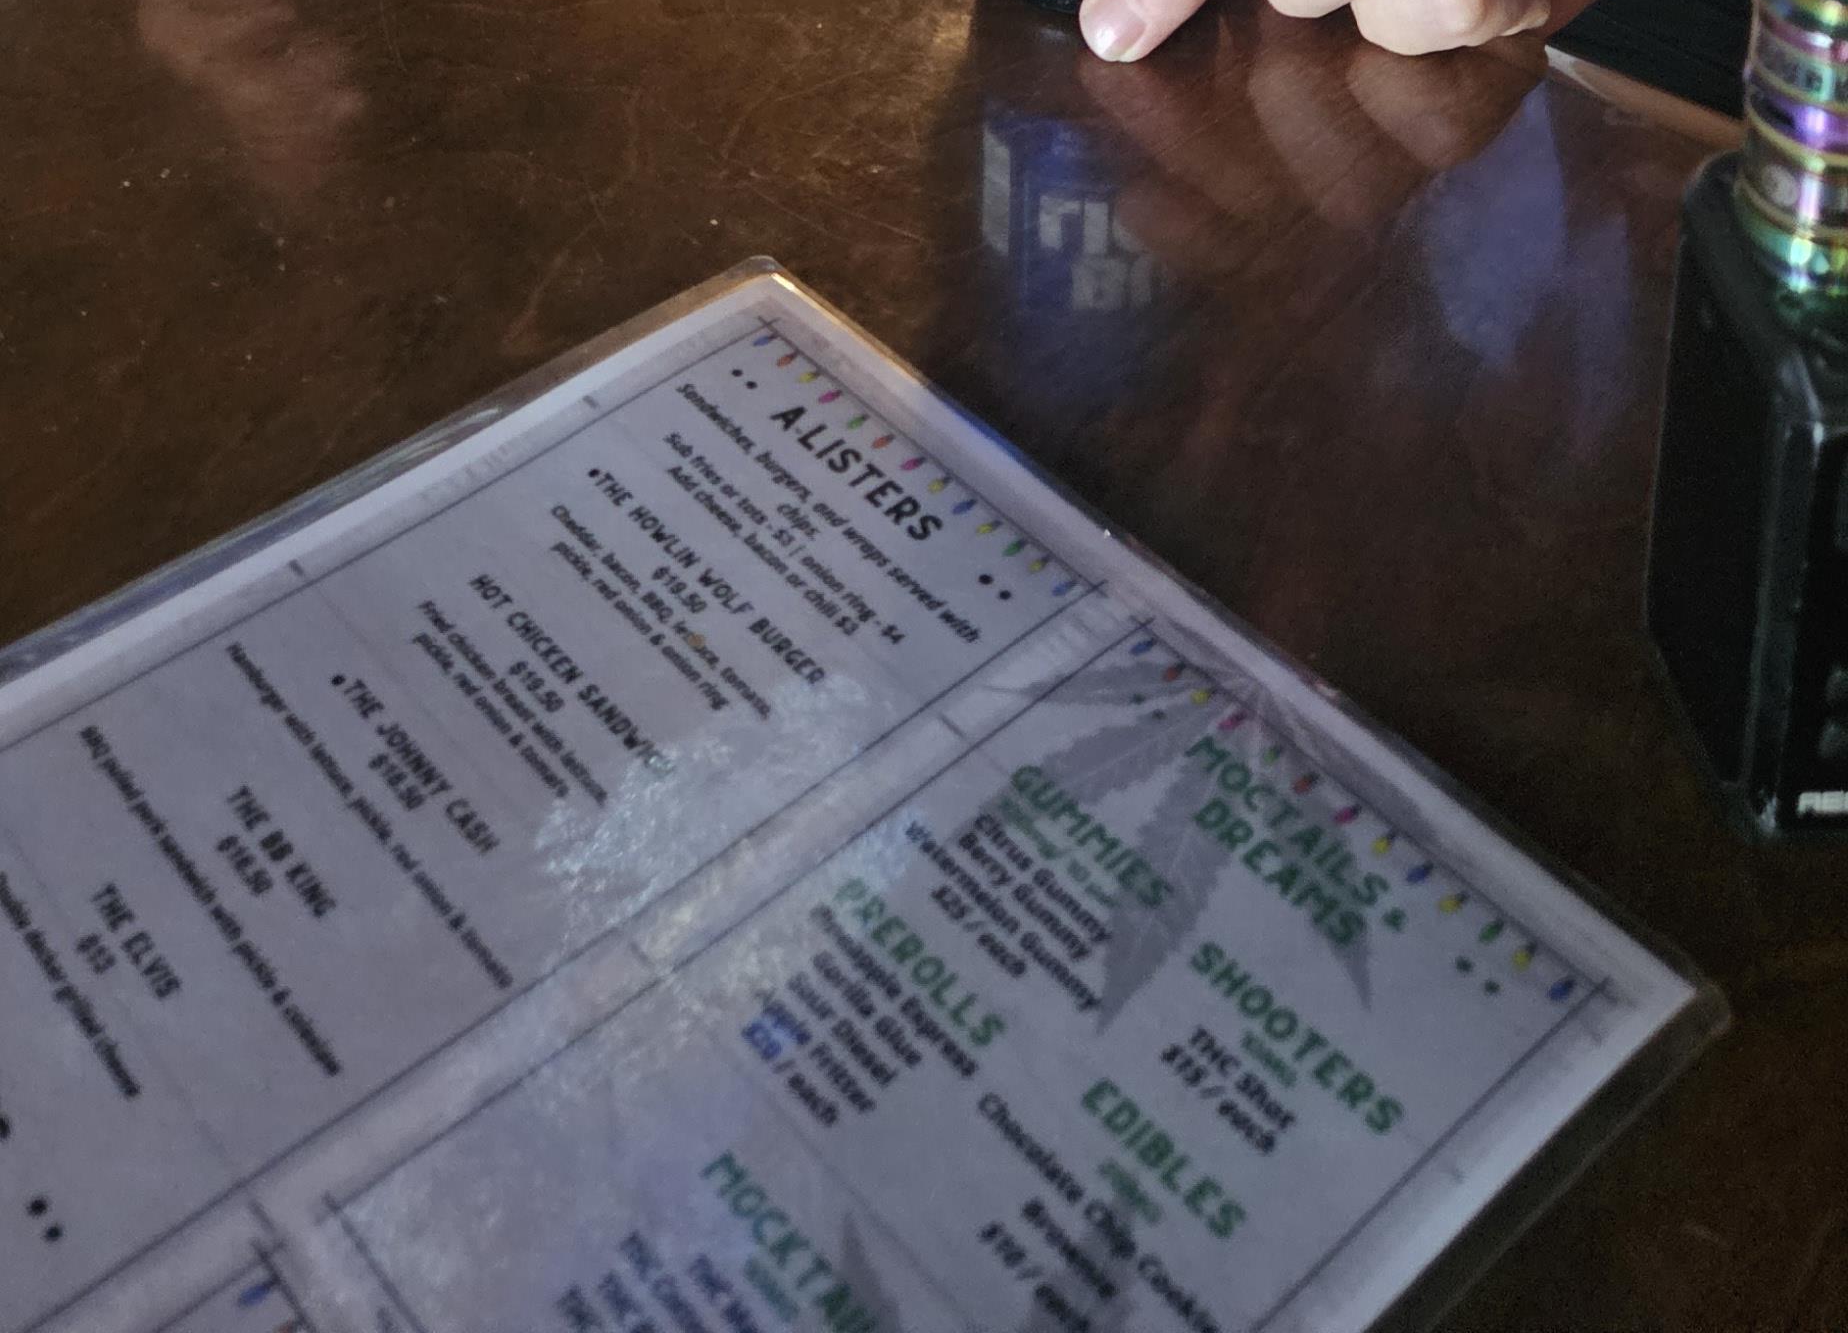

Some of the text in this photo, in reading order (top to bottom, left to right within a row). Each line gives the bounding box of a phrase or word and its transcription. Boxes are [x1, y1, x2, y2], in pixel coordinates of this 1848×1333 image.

[551, 505, 602, 552] Cheddar,
[600, 552, 641, 594] bacon,
[640, 591, 673, 624] BBQ,
[671, 620, 720, 670] letuce,
[595, 472, 825, 684] THE HOWLIN WOLF BURGER
[676, 383, 756, 455] Sandwiches,
[754, 450, 812, 504] burgers,
[842, 526, 892, 568] wraps
[887, 567, 946, 611] served
[938, 609, 980, 643] with
[690, 455, 723, 486] fries
[736, 497, 768, 526] tots
[800, 555, 845, 594] onion
[841, 592, 876, 623] ring
[693, 490, 743, 537] cheese,
[742, 532, 789, 575] bacon
[803, 589, 840, 619] chili
[470, 574, 678, 773] HOT CHICKEN SANDWIC
[550, 541, 593, 580] pickle,
[613, 599, 653, 636] onion
[660, 645, 702, 684] onion
[698, 681, 730, 711] ring
[344, 679, 497, 853] THE JOHNNY CASH
[1009, 763, 1176, 912] GUMMIES
[1184, 734, 1391, 908] MOCTAILS
[831, 875, 1006, 1048] PREROLLS
[1192, 797, 1369, 956] DREAMS
[1189, 940, 1404, 1136] SHOOTERS
[701, 1148, 882, 1333] MOCKTAI
[1079, 1077, 1248, 1240] EDIBLES
